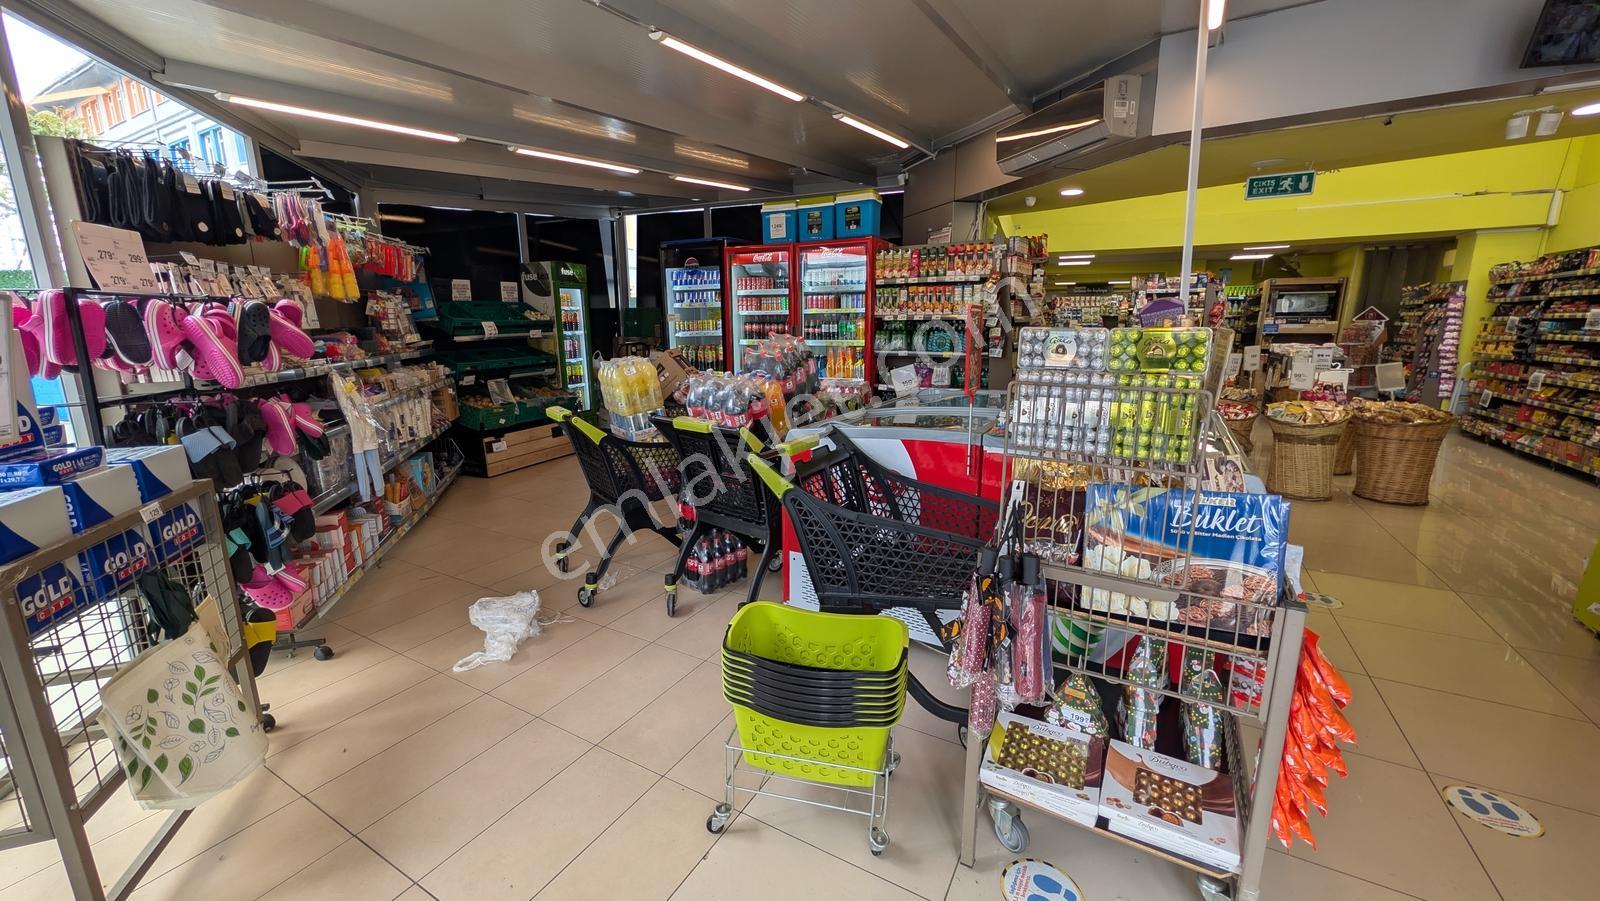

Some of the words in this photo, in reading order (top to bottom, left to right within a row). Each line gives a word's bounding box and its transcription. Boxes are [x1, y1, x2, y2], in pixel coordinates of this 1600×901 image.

[1252, 187, 1274, 195] EXIT
[560, 267, 574, 276] fuse
[52, 460, 72, 472] GOLD
[163, 513, 196, 541] GOLD
[21, 575, 73, 617] GOLD
